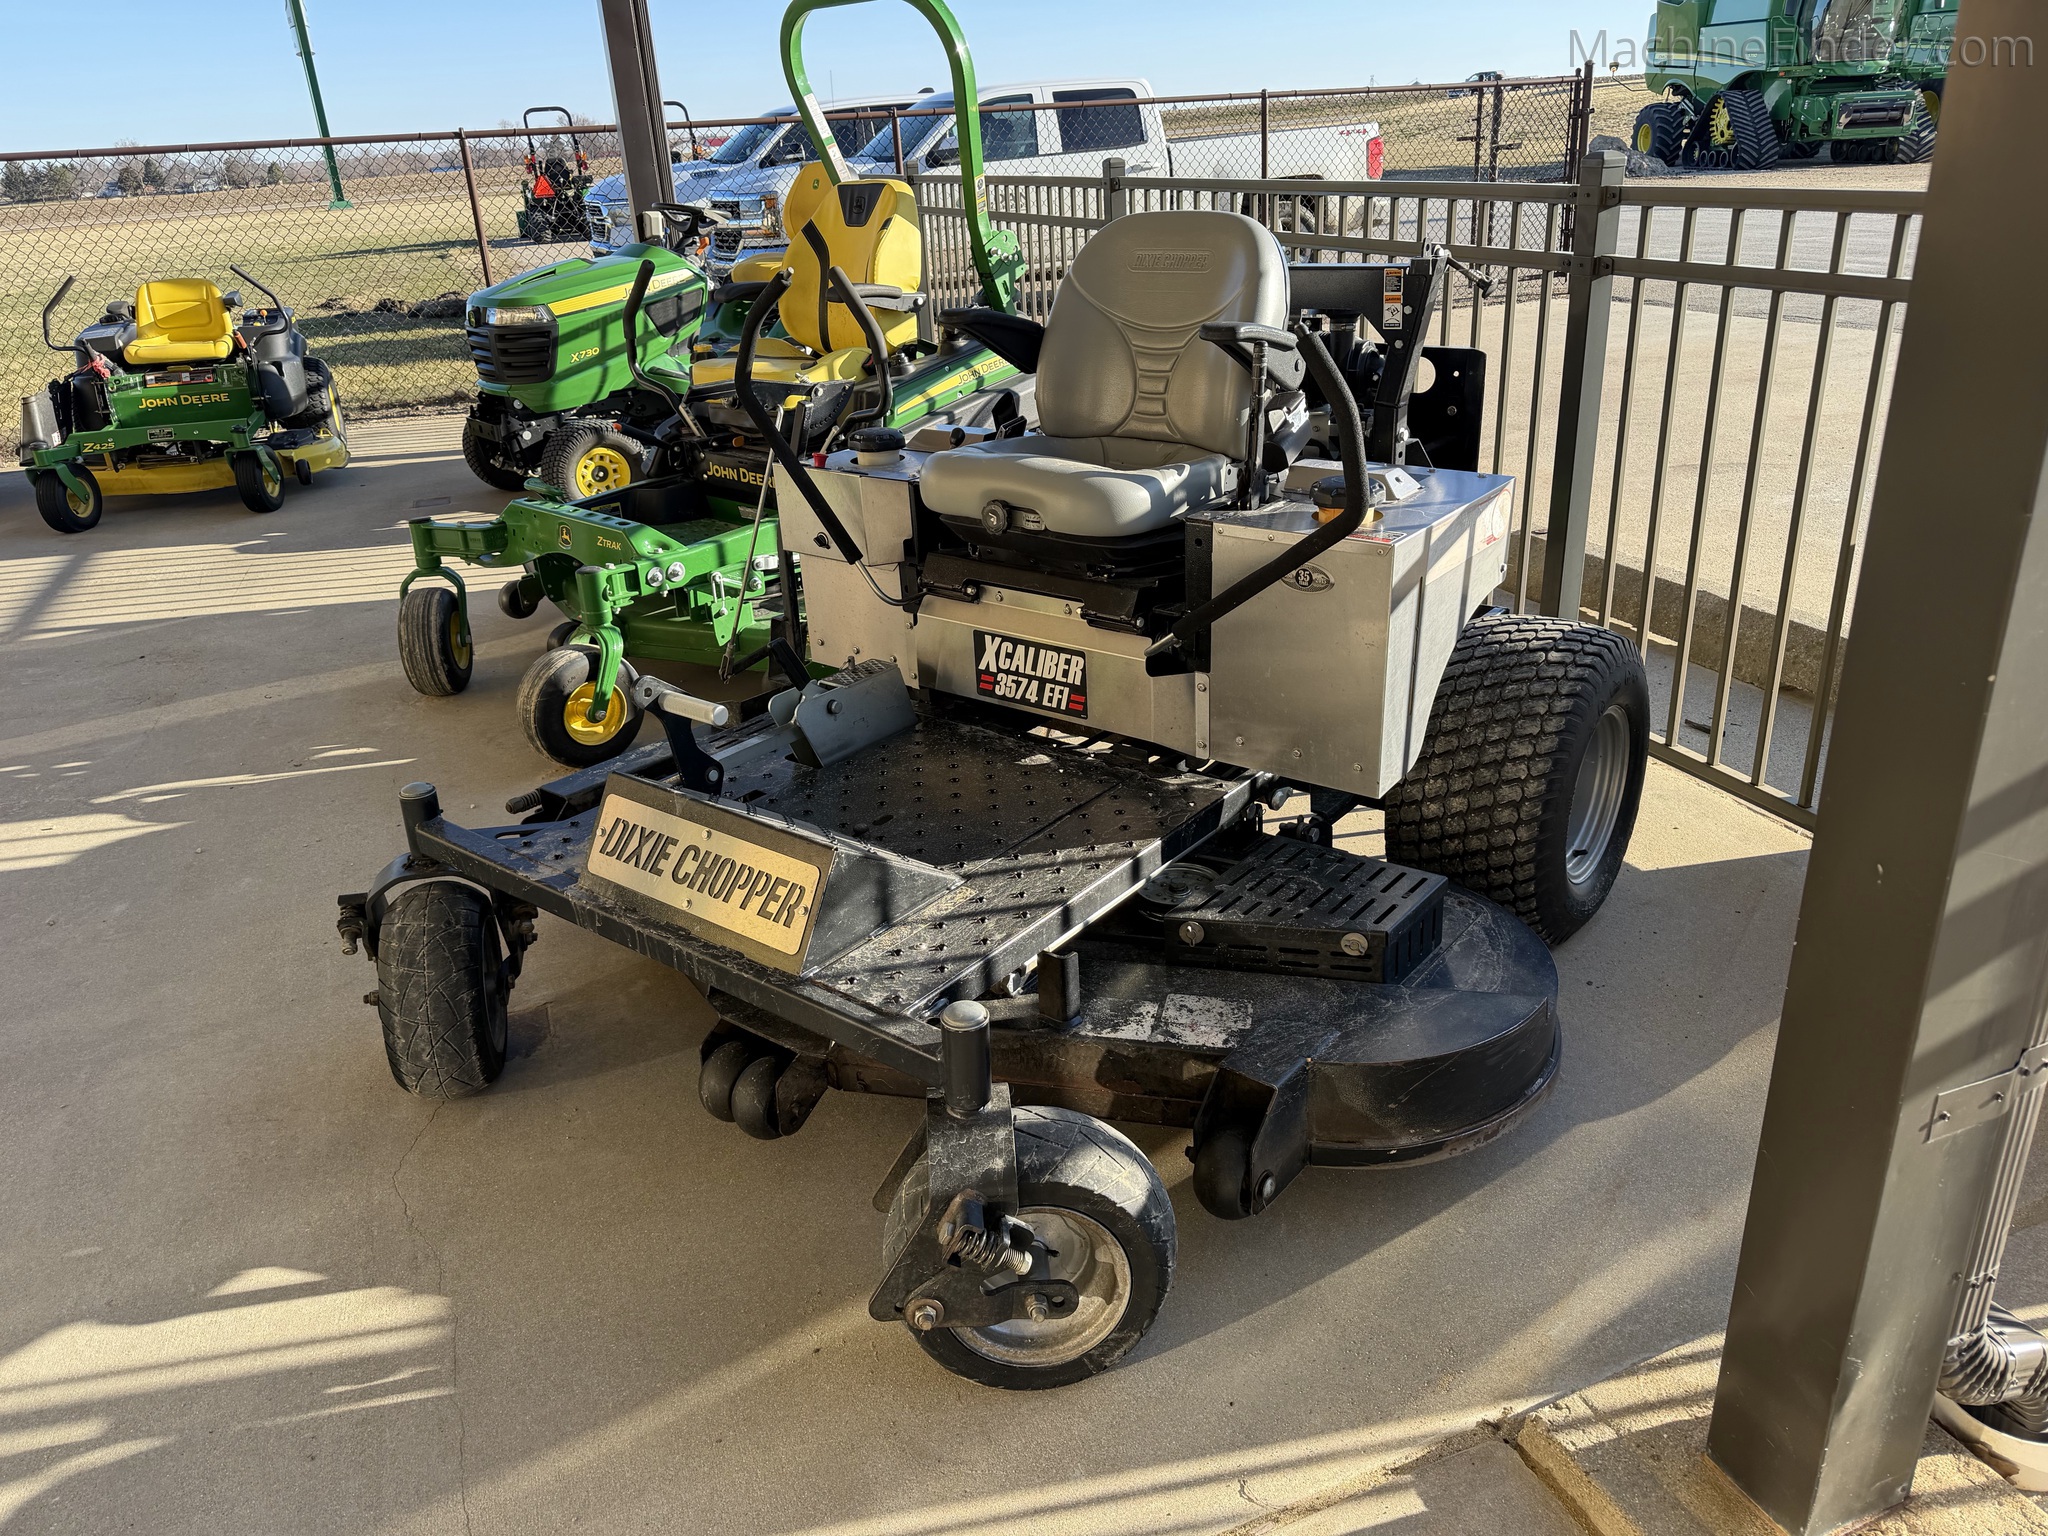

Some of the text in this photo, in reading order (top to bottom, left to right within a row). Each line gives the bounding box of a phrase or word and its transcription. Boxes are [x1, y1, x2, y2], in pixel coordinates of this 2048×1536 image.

[570, 346, 601, 363] X730
[958, 367, 981, 385] JOHN
[138, 393, 231, 409] JOHN DEERE
[82, 442, 115, 453] Z425
[707, 461, 738, 481] JOHN
[597, 535, 622, 551] ZTRAK
[1298, 569, 1311, 582] 35
[978, 634, 1085, 686] XCALIBER
[994, 672, 1070, 711] 3574 EFI
[598, 816, 807, 929] DIXIE CHOPPER
